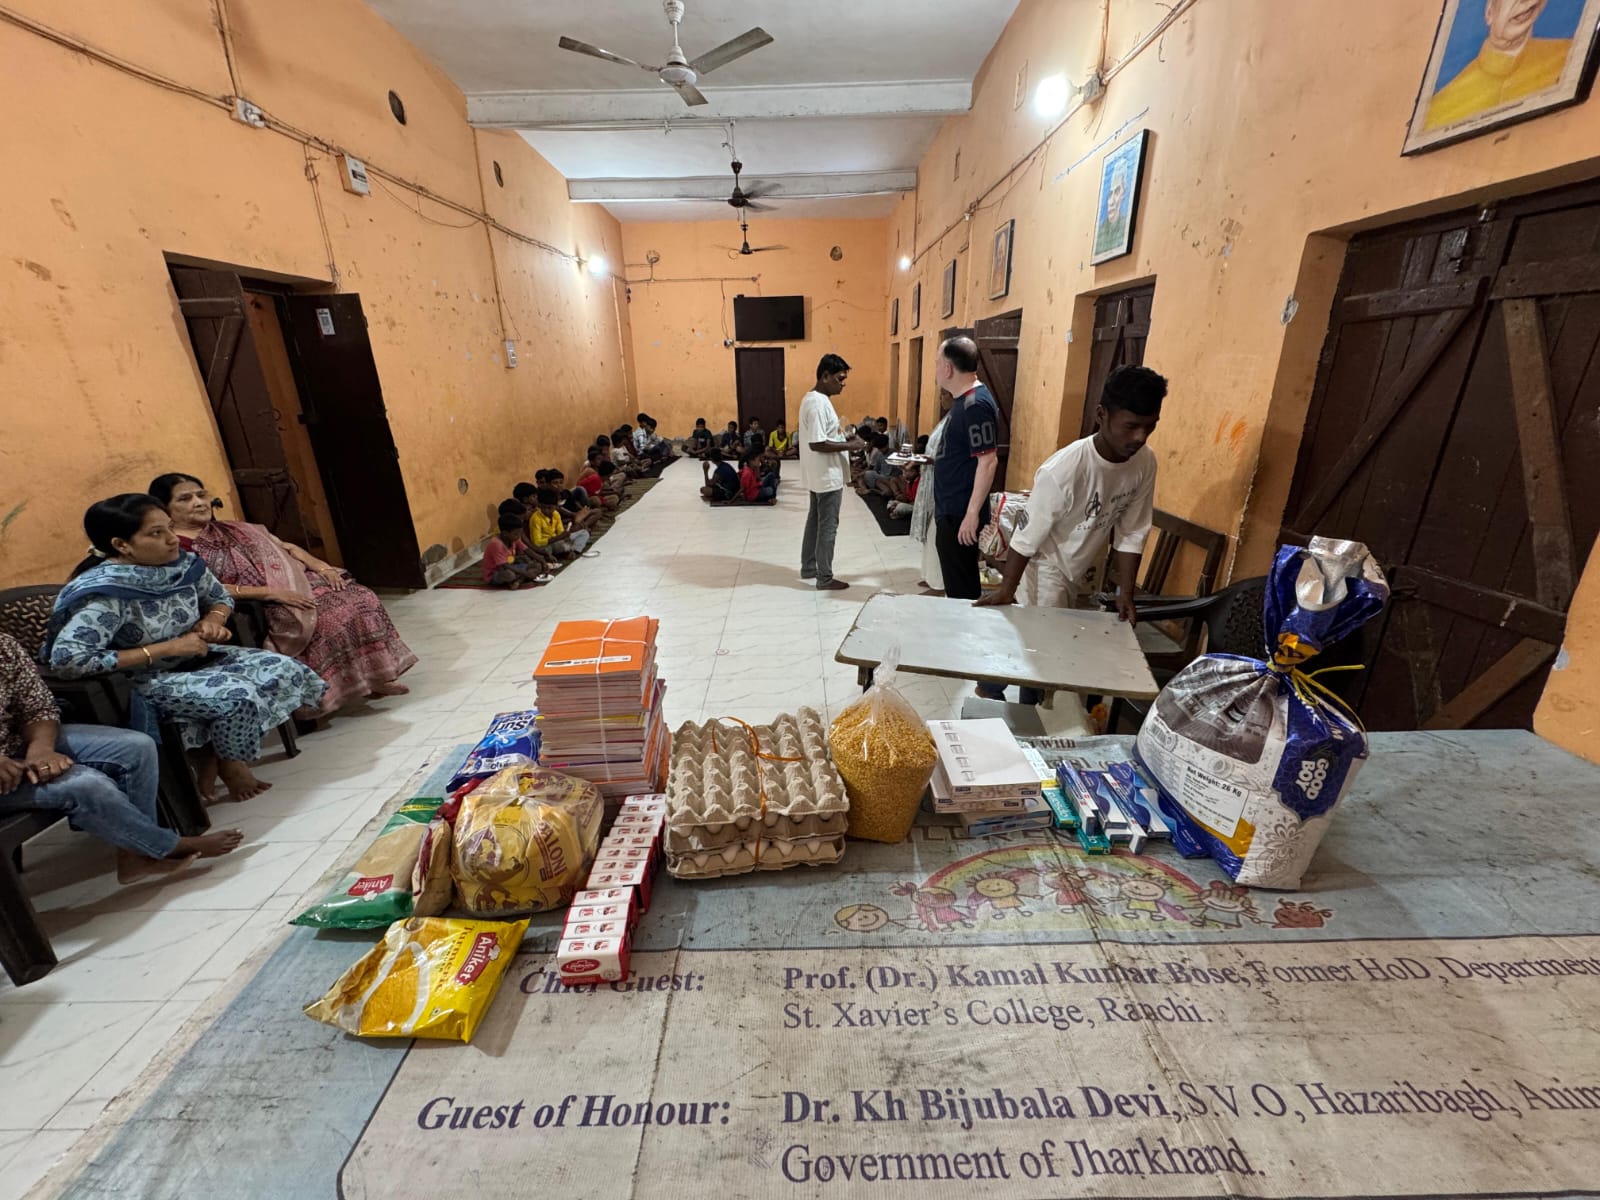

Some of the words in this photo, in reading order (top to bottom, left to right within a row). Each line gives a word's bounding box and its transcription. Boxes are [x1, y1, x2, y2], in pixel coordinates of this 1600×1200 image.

[969, 421, 994, 447] 60
[1296, 760, 1315, 792] BOY
[1306, 758, 1329, 800] GOOD
[459, 936, 492, 981] Aniket
[783, 966, 857, 990] Prof.
[865, 965, 939, 994] (Dr.)
[945, 962, 1049, 987] Kamal
[1051, 961, 1160, 985] Kumar
[783, 1001, 821, 1029] St.
[832, 1000, 960, 1028] Xavier's
[966, 997, 1096, 1031] College,
[1096, 996, 1213, 1023] Ranchi.
[416, 1096, 525, 1130] Guest
[532, 1094, 578, 1130] of
[576, 1094, 731, 1127] Honour:
[781, 1090, 841, 1123] Dr.
[850, 1089, 909, 1122] Kh
[917, 1087, 1076, 1130] Bijubala
[781, 1144, 1011, 1183] Government
[1019, 1139, 1061, 1180] of
[1064, 1137, 1266, 1178] Jharkhand.
